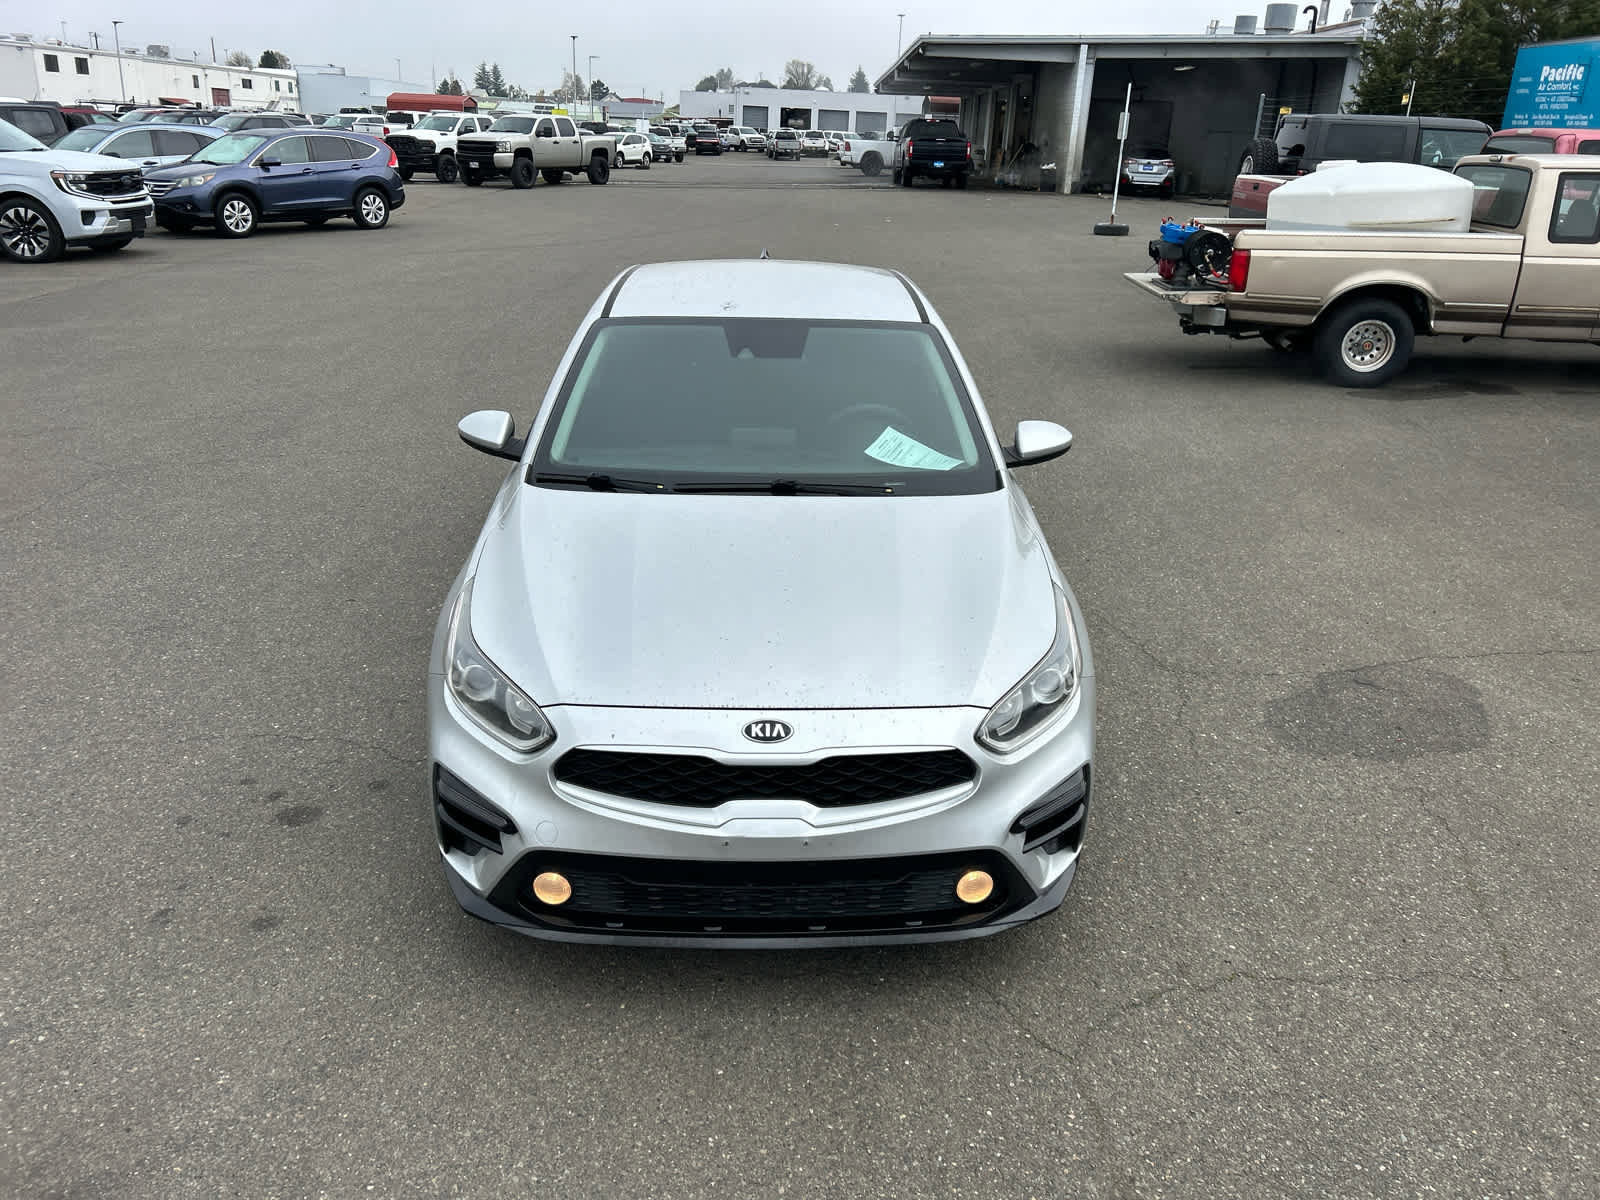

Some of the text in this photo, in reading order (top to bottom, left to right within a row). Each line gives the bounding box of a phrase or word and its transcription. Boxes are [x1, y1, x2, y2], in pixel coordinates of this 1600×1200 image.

[1540, 64, 1585, 82] Pacific
[1546, 81, 1572, 91] Comfort
[751, 723, 785, 737] KIA
